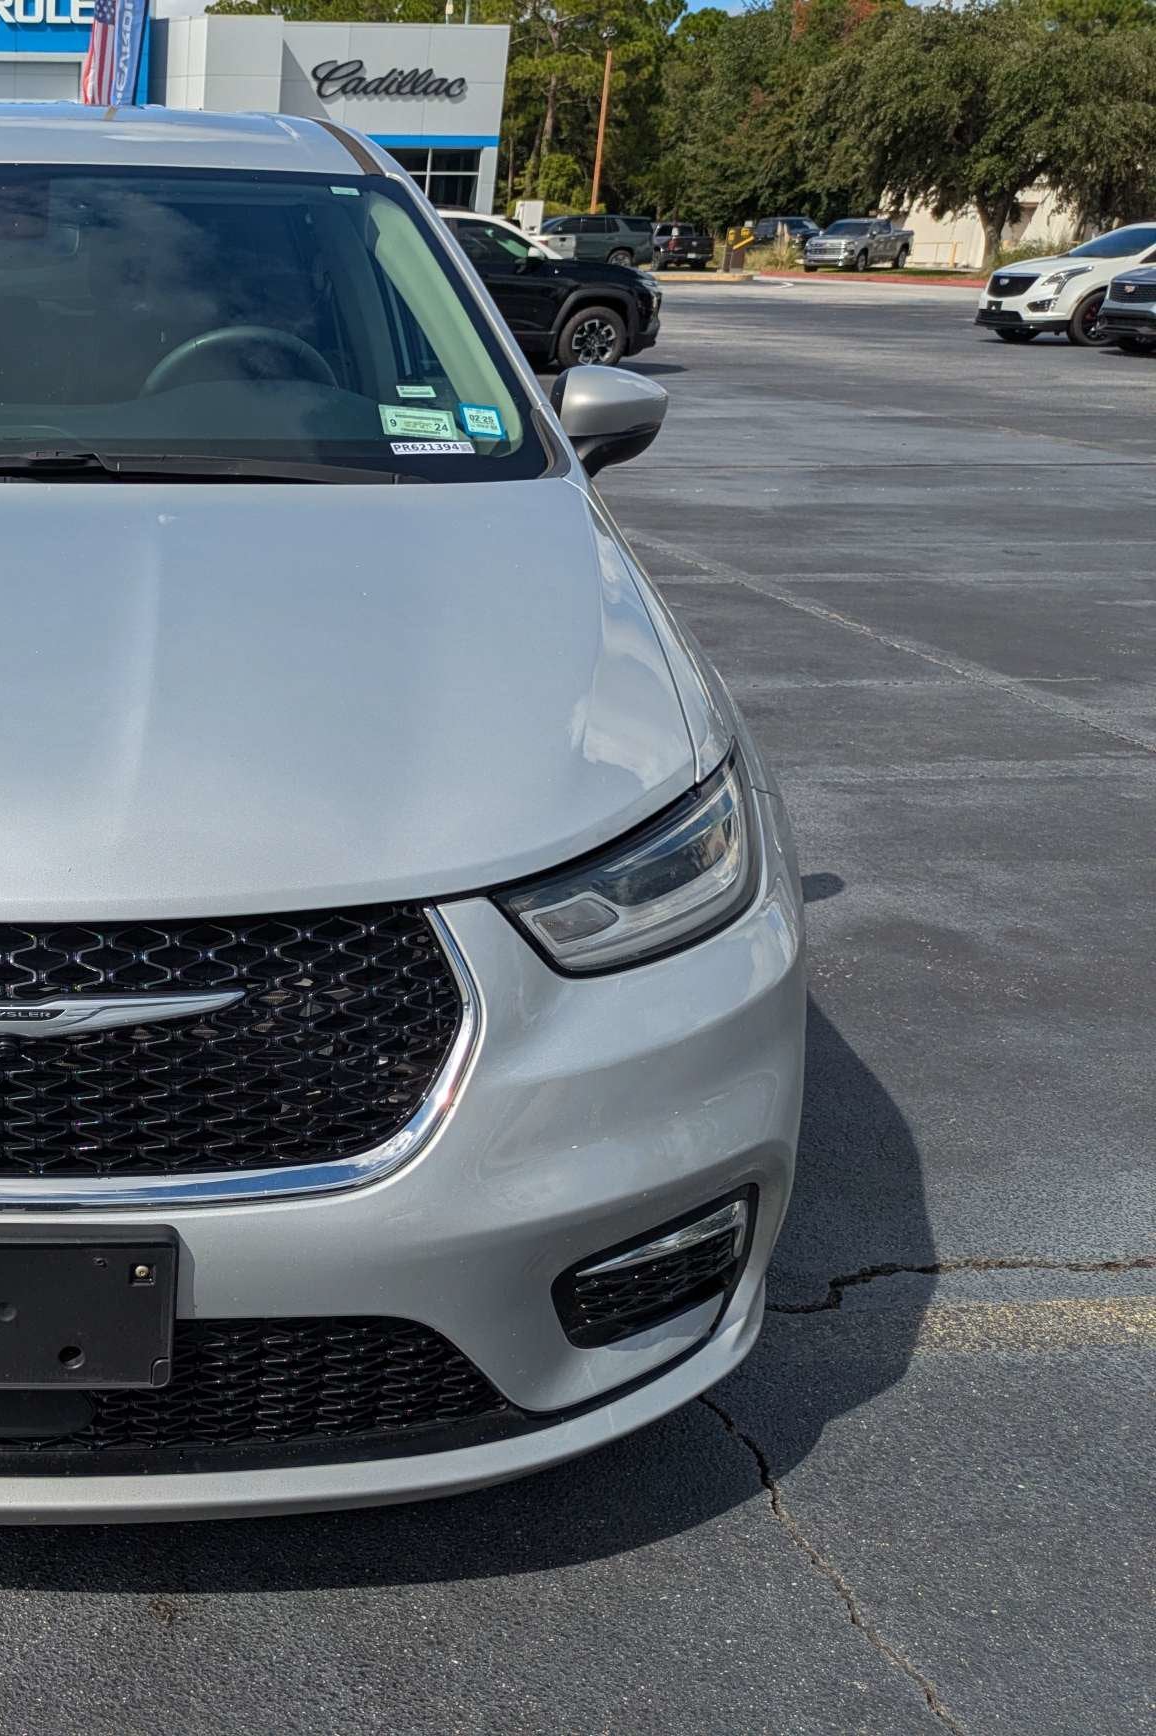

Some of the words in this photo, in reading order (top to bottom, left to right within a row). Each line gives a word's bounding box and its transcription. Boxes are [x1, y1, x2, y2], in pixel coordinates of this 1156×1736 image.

[311, 59, 466, 99] Cadillac
[389, 418, 397, 427] 9
[434, 423, 449, 432] 24
[393, 443, 459, 452] PR621394
